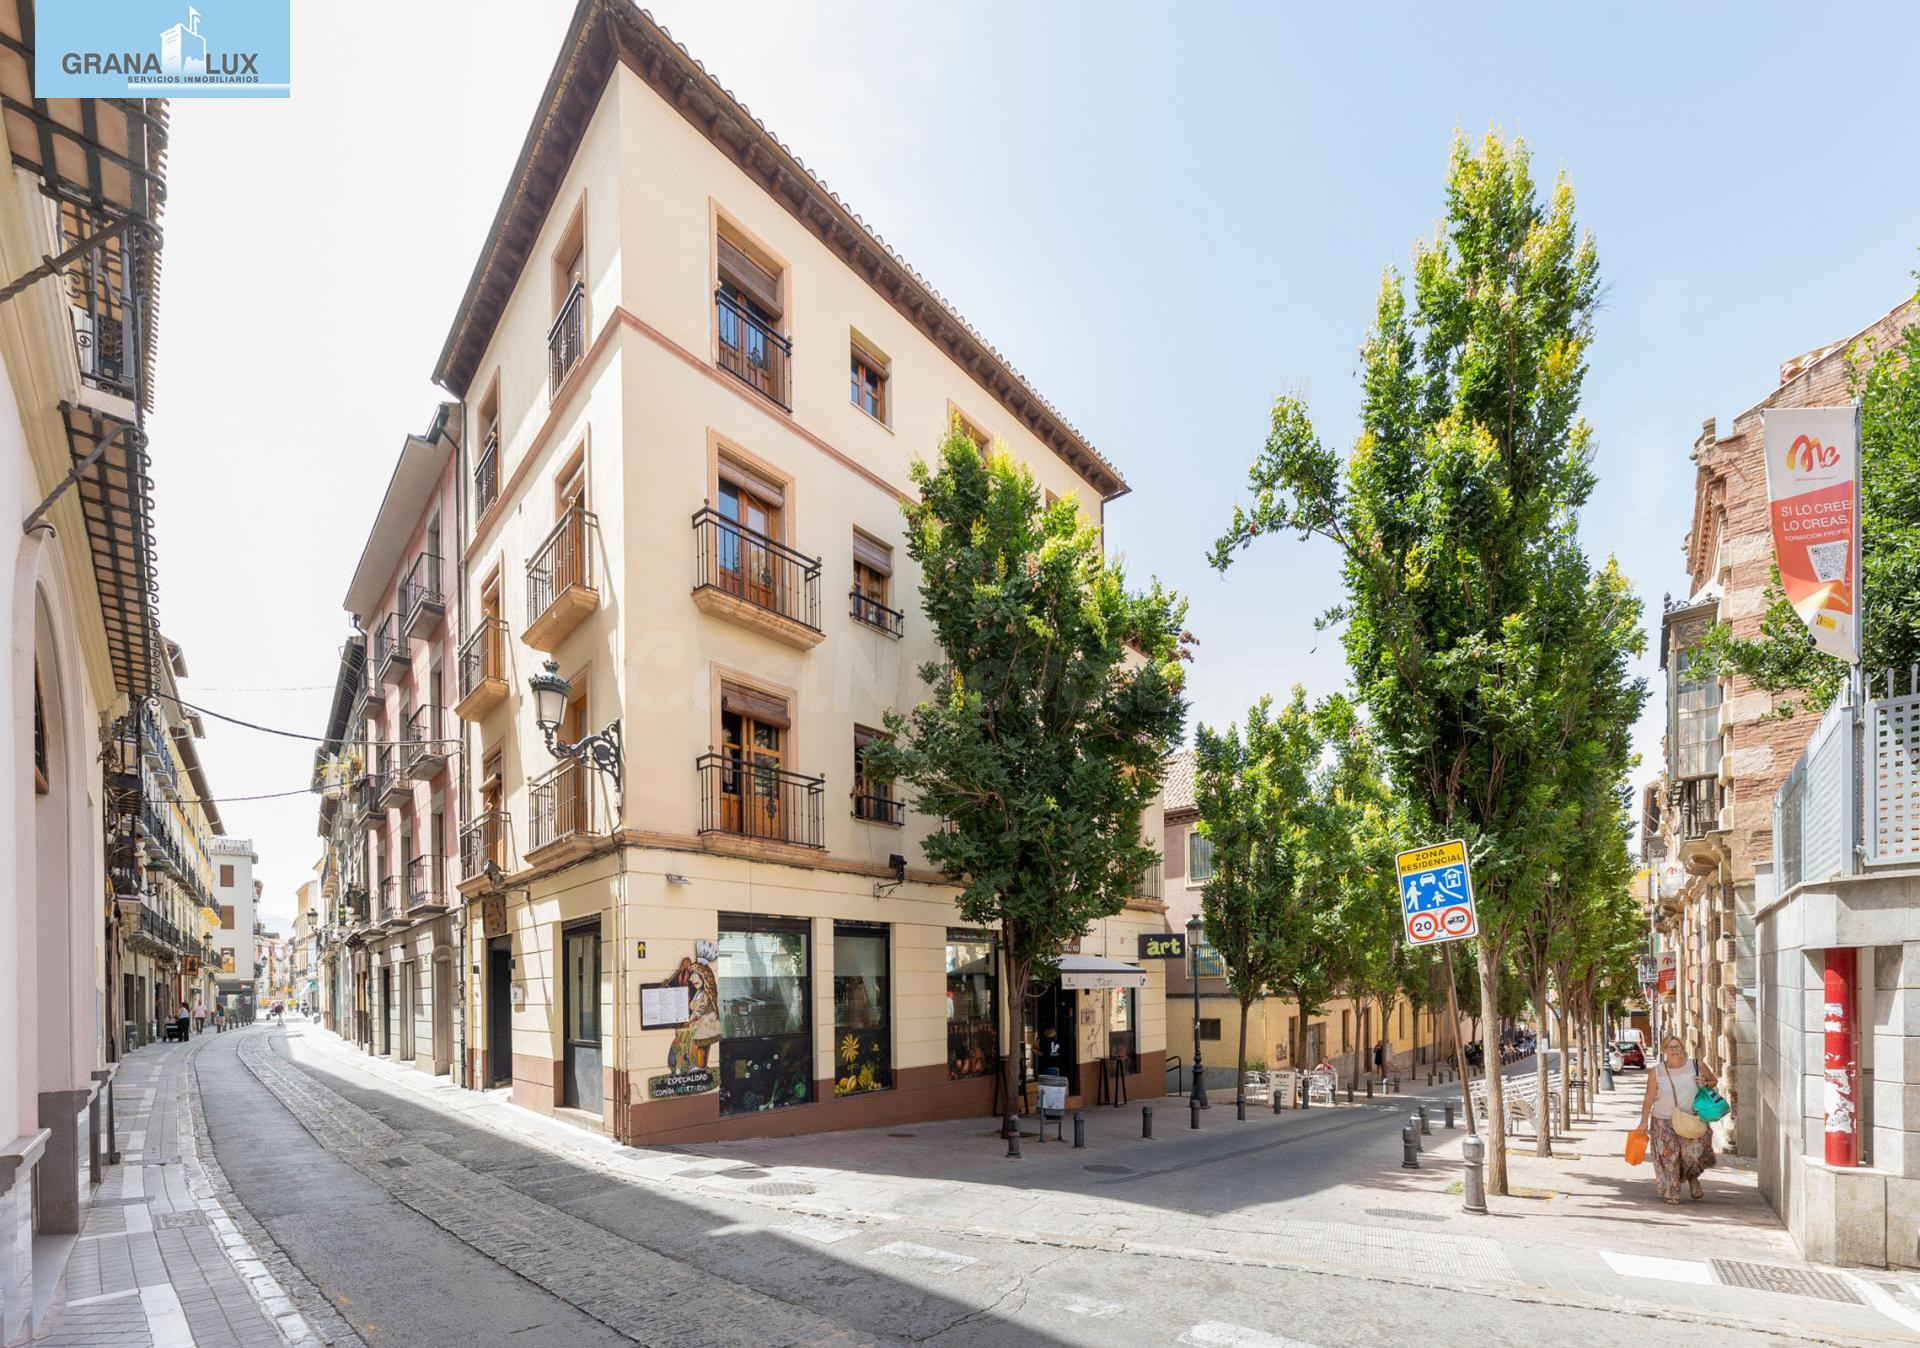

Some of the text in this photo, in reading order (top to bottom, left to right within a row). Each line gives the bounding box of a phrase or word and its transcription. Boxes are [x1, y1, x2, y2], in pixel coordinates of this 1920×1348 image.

[1781, 499, 1853, 517] SI LO CREE
[1783, 515, 1848, 532] LO CREAS
[1401, 854, 1462, 872] RESIDENCIAL
[1415, 849, 1445, 861] ZONA
[1415, 921, 1432, 932] 20
[1147, 938, 1180, 956] art
